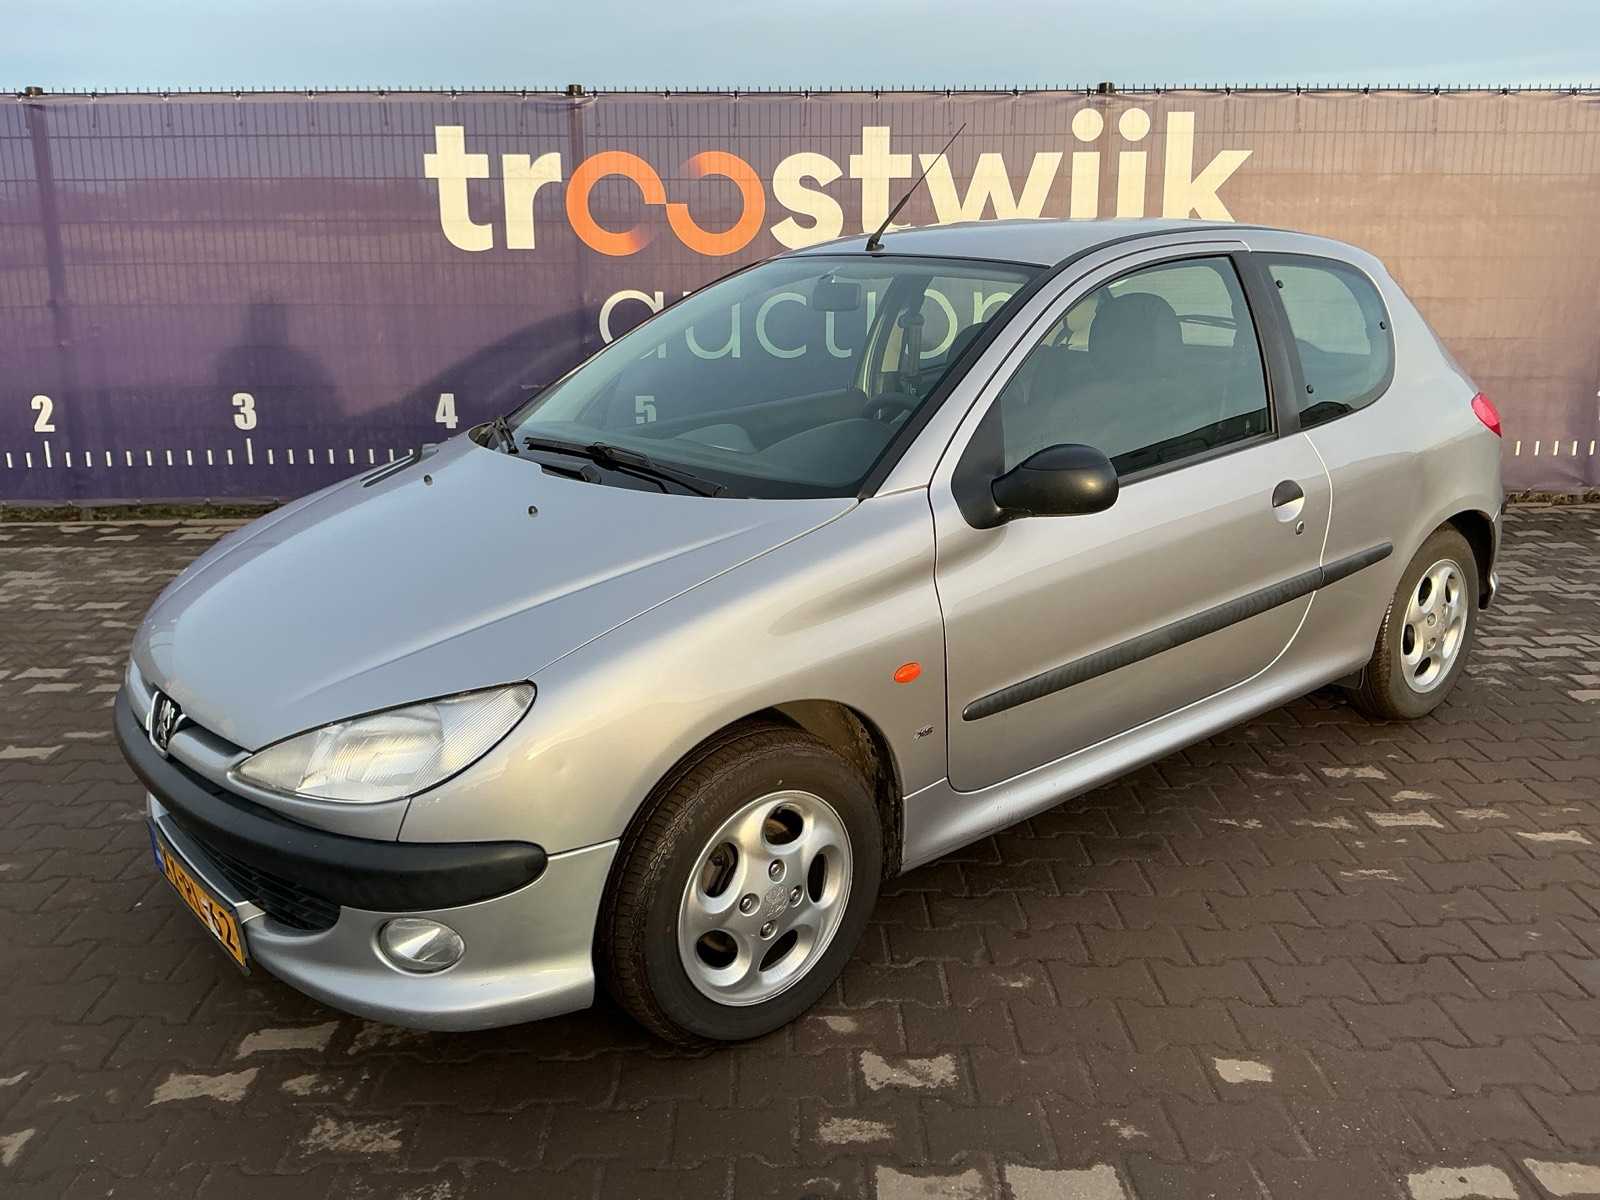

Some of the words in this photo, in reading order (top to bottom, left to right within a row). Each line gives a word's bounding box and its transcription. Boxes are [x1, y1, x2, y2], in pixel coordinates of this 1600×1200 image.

[423, 108, 1253, 256] troostwijk
[31, 395, 56, 433] 2
[232, 392, 257, 430] 3
[435, 393, 458, 429] 4
[635, 395, 657, 424] 5
